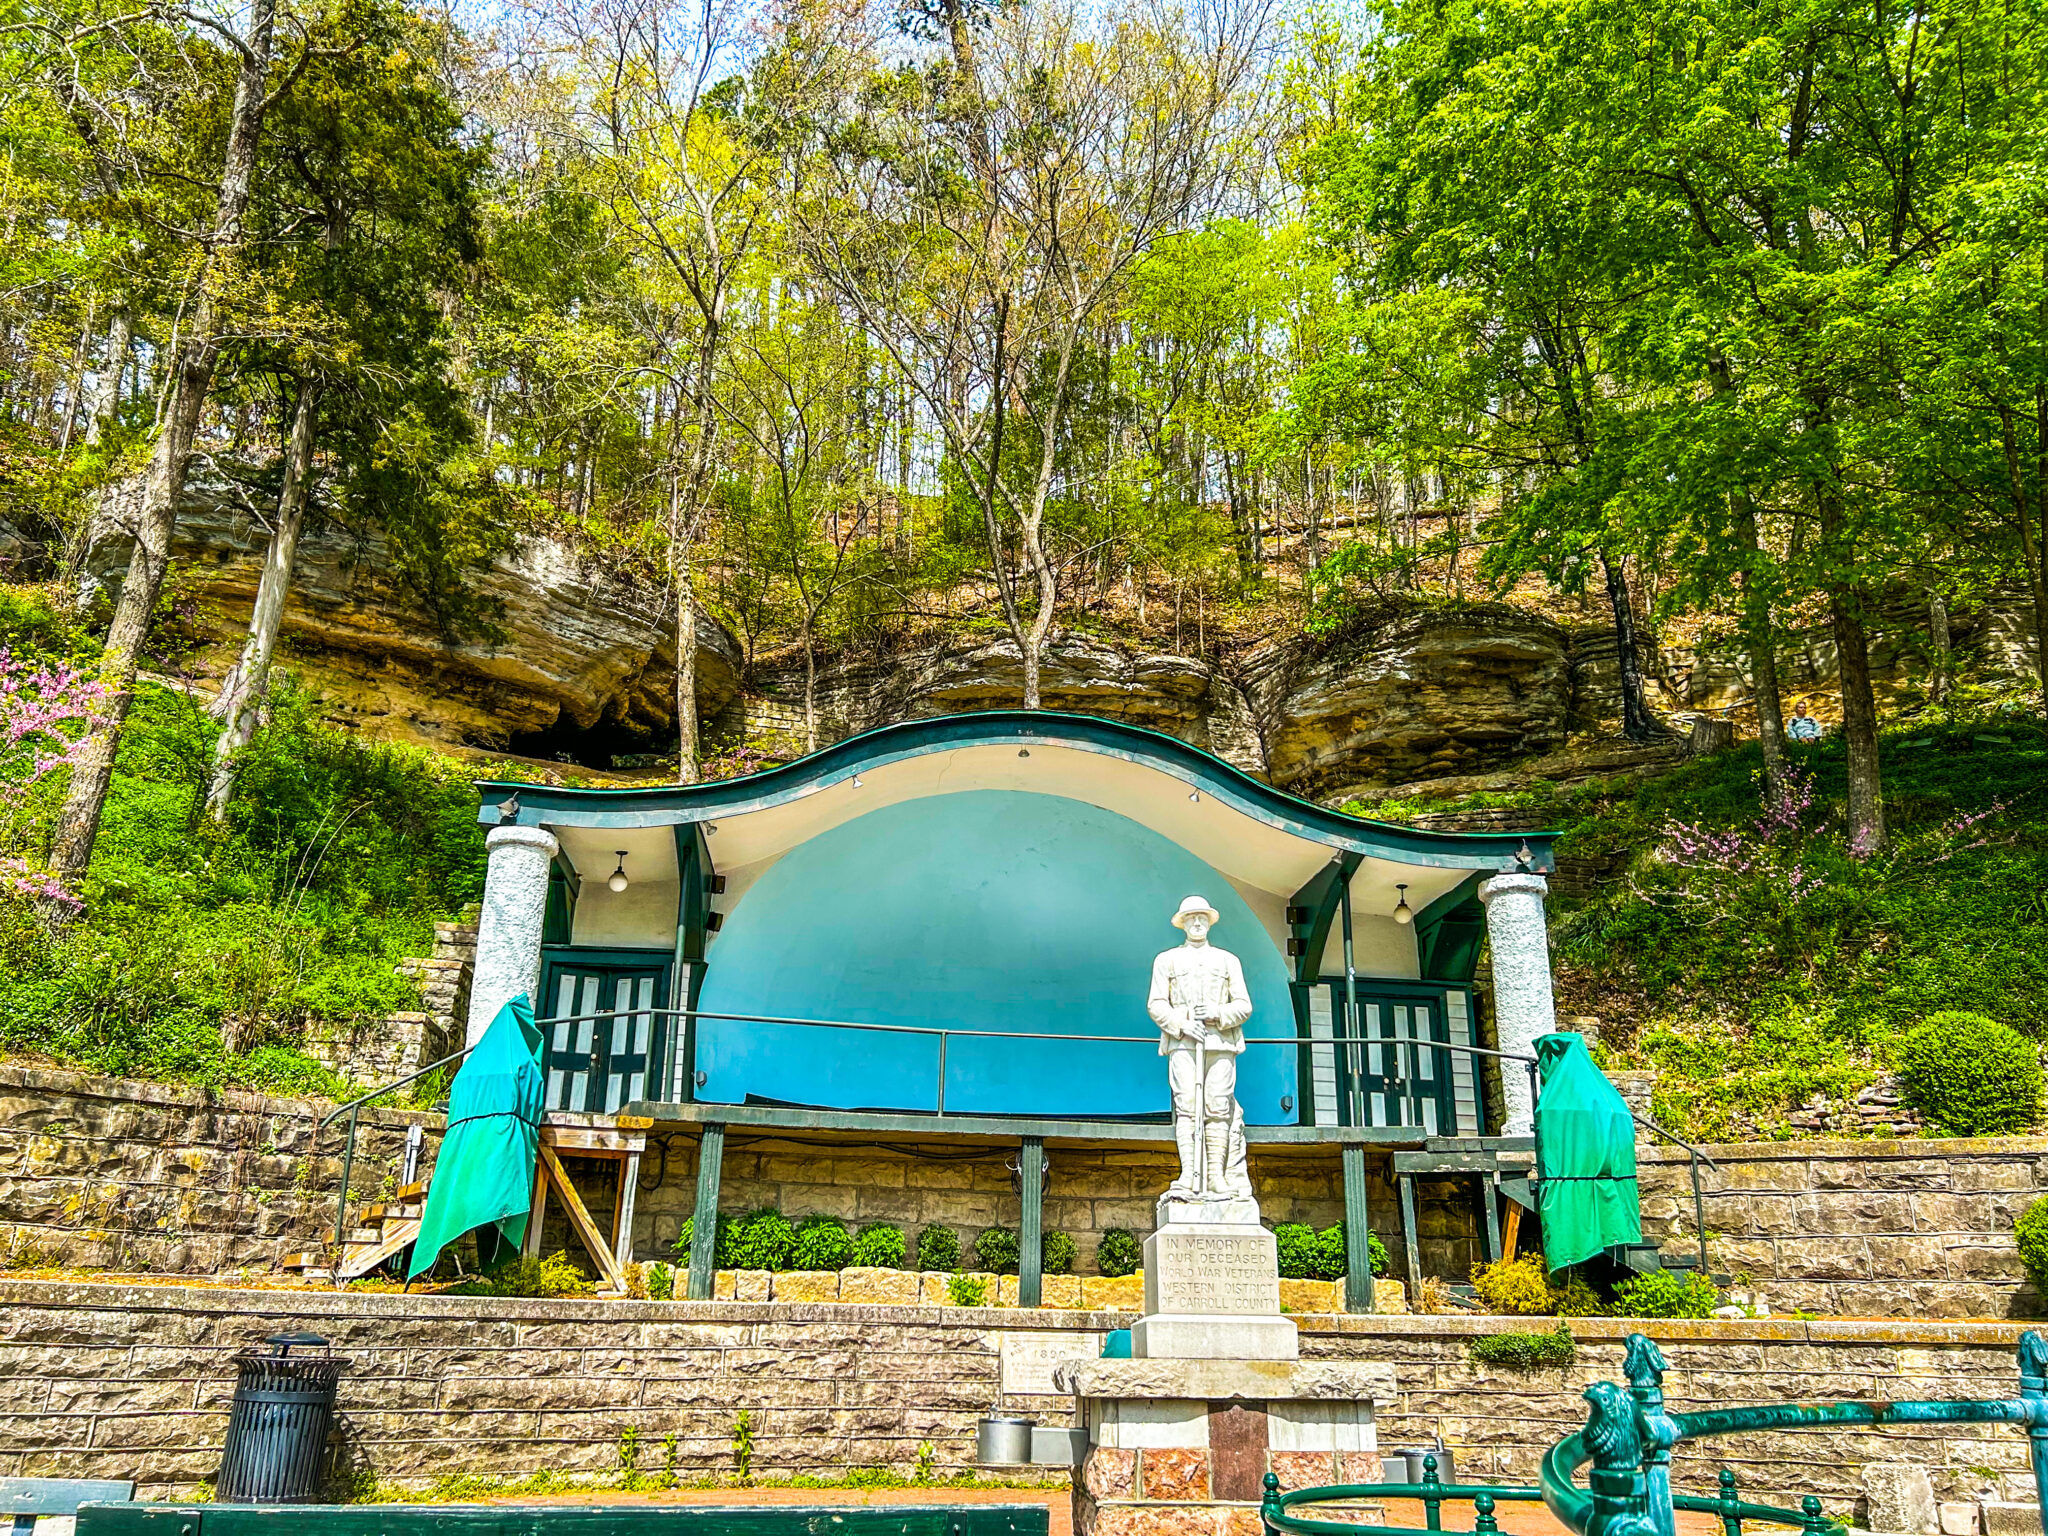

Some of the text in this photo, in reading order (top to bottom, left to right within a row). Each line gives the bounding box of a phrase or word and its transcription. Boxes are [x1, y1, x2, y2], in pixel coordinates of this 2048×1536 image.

[1167, 1238, 1267, 1250] IN MEMORY OF
[1168, 1253, 1267, 1264] OUR DECEASED
[1163, 1282, 1273, 1295] WESTERN DISTRICT
[1161, 1296, 1278, 1310] OF CARROLL COUNTY
